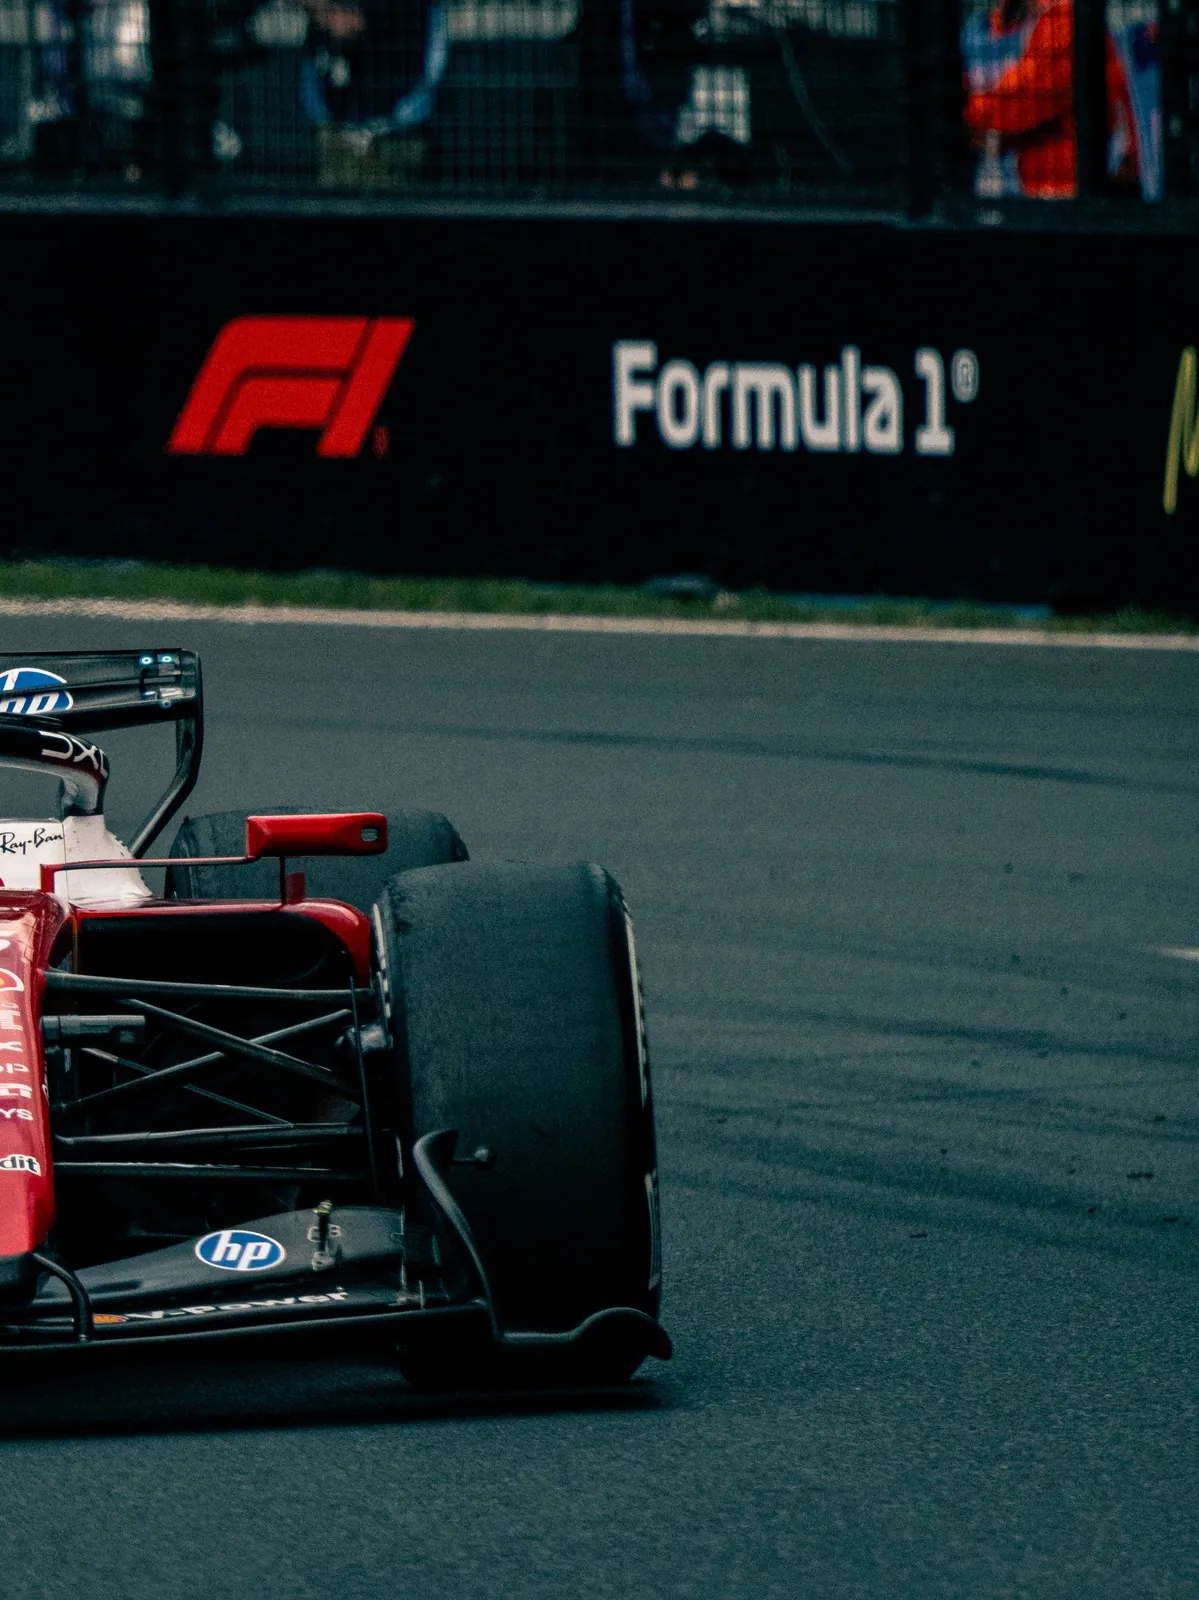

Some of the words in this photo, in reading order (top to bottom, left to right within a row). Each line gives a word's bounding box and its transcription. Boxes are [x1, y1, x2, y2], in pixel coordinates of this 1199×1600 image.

[612, 340, 903, 453] Formula
[207, 1230, 274, 1270] hp
[126, 1291, 349, 1320] V-Power
